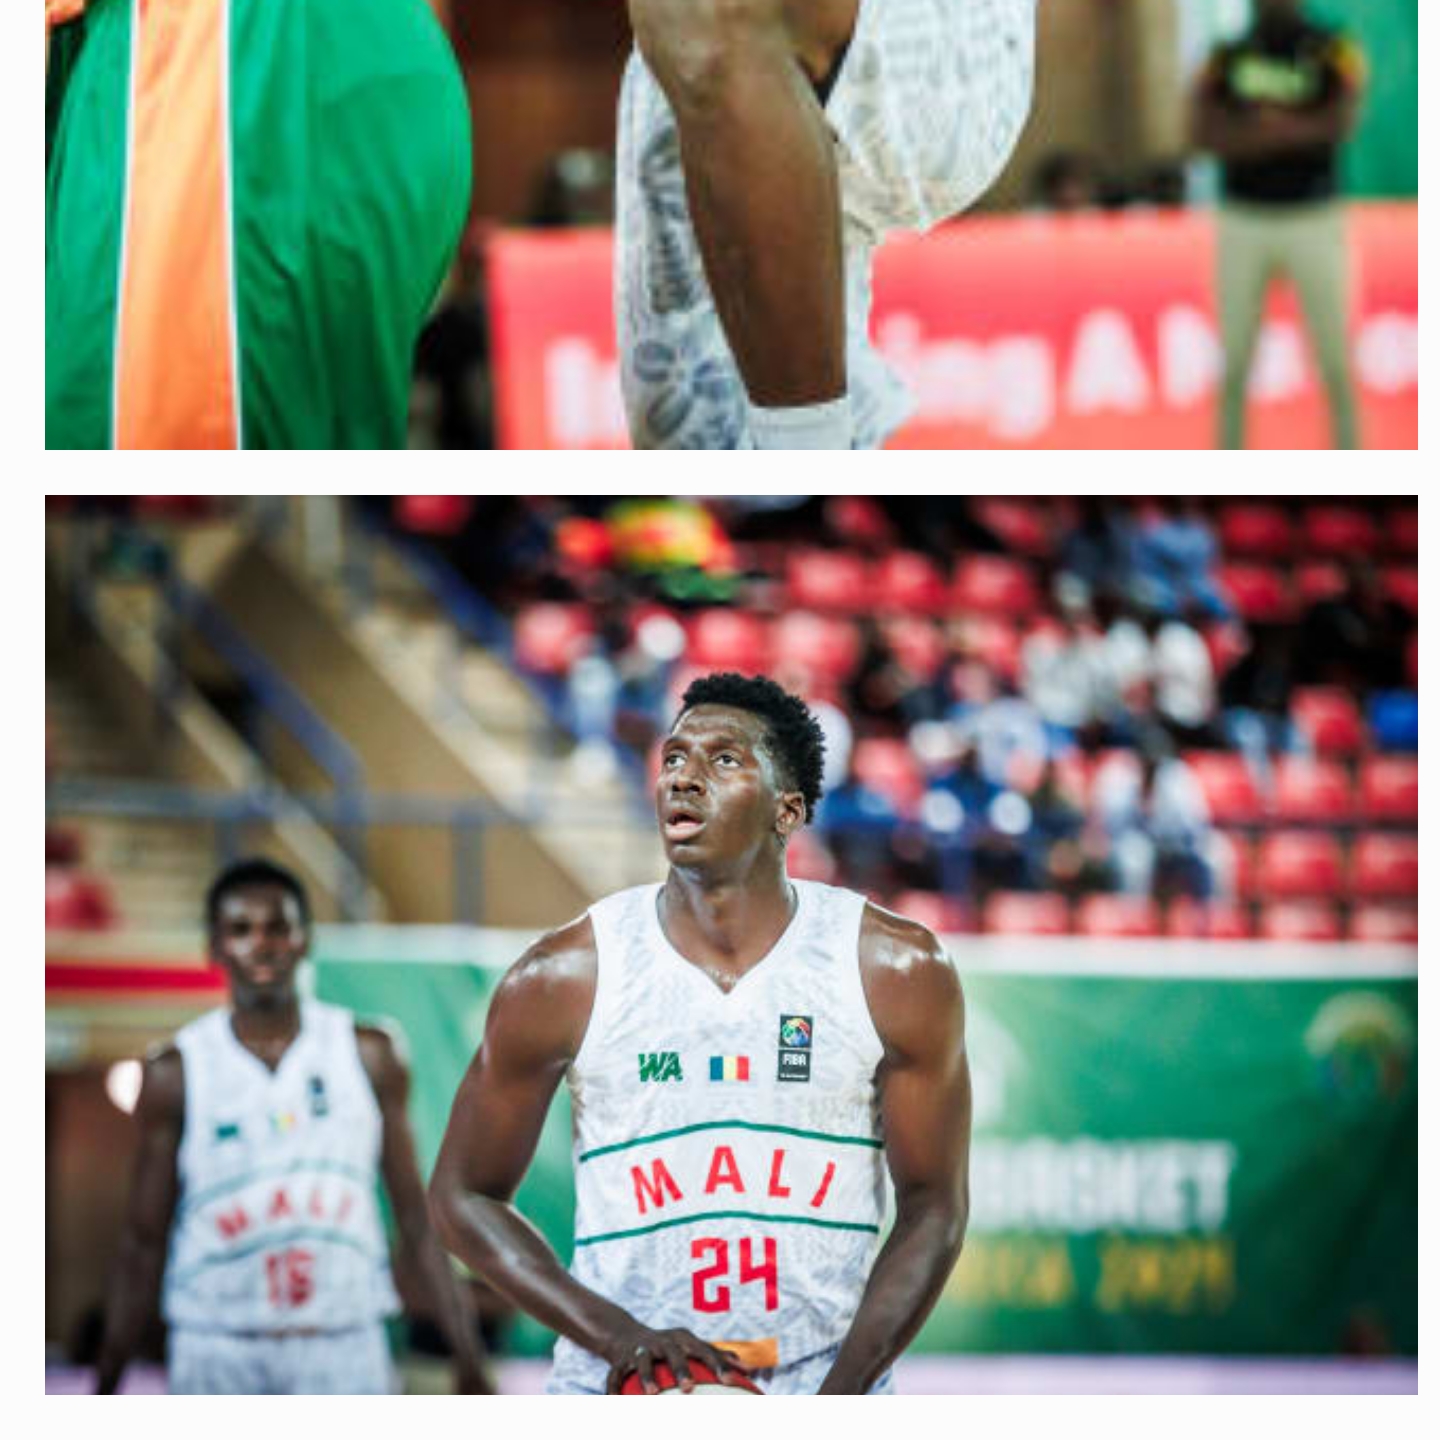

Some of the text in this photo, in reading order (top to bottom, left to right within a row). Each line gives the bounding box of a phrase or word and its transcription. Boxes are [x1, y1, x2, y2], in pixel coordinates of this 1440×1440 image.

[638, 1052, 684, 1082] WA
[630, 1145, 837, 1215] MALI
[215, 1187, 353, 1240] MALI
[690, 1236, 779, 1314] 24
